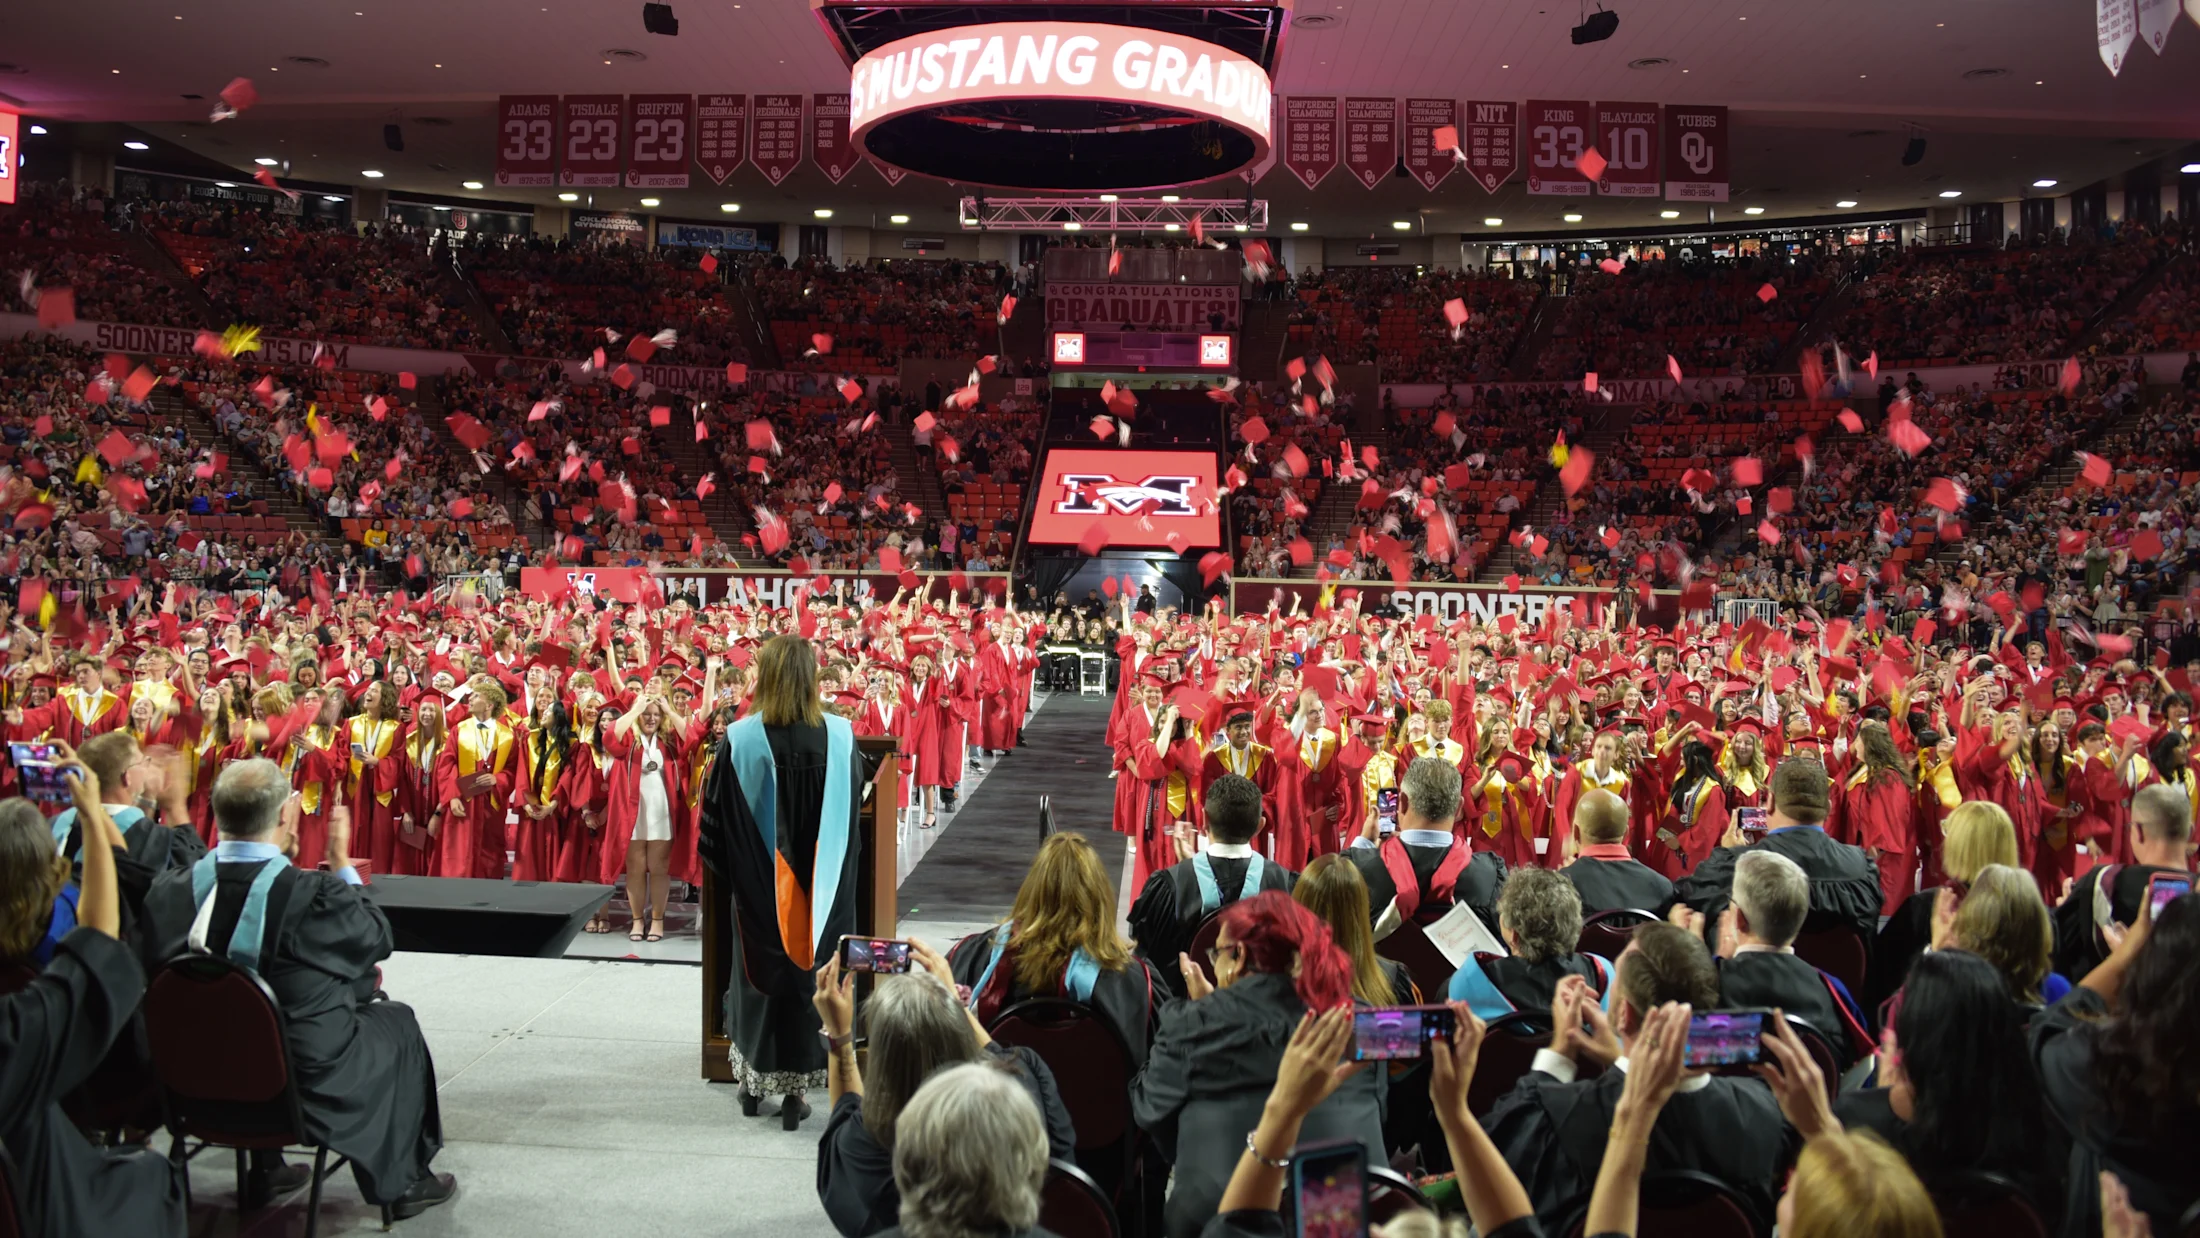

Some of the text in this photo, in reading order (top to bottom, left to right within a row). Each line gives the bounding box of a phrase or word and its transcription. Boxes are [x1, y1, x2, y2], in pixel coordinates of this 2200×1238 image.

[868, 35, 1100, 110] MUSTANG
[710, 97, 733, 106] NCAA
[766, 98, 790, 106] NCAA
[826, 96, 849, 105] NCAA
[1288, 100, 1336, 109] CONFERENCE
[1347, 101, 1394, 110] CONFERENCE
[508, 104, 551, 116] ADAMS
[569, 104, 619, 116] TISDALE
[637, 103, 684, 115] GRIFFIN
[699, 107, 744, 116] REGIONALS
[756, 107, 800, 117] REGIONALS
[815, 106, 850, 115] REGIONA
[1290, 109, 1334, 118] CHAMPIONS
[1348, 110, 1393, 118] CHAMPIONS
[1409, 108, 1452, 116] TOURNAMENT
[1476, 104, 1508, 123] NIT
[1543, 109, 1574, 122] KING
[1600, 112, 1656, 124] BLAYLOCK
[1677, 114, 1717, 127] TUBBS
[503, 119, 552, 160] 33
[568, 119, 617, 160] 23
[634, 119, 685, 161] 23
[818, 140, 833, 148] 2021
[1533, 125, 1584, 168] 33
[1607, 127, 1648, 170] 10
[1681, 132, 1713, 174] OU
[648, 177, 686, 186] 2007-2009
[1551, 184, 1587, 193] 1985-1989
[1620, 185, 1655, 194] 1987-1989
[1679, 188, 1716, 197] 1980-1994
[194, 187, 269, 203] 2002 FINAL FOUR
[574, 221, 643, 231] GYMNASTICS
[579, 216, 638, 226] OKLAHOMA
[726, 229, 754, 247] ICE
[1061, 285, 1223, 298] CONGRATULATIONS
